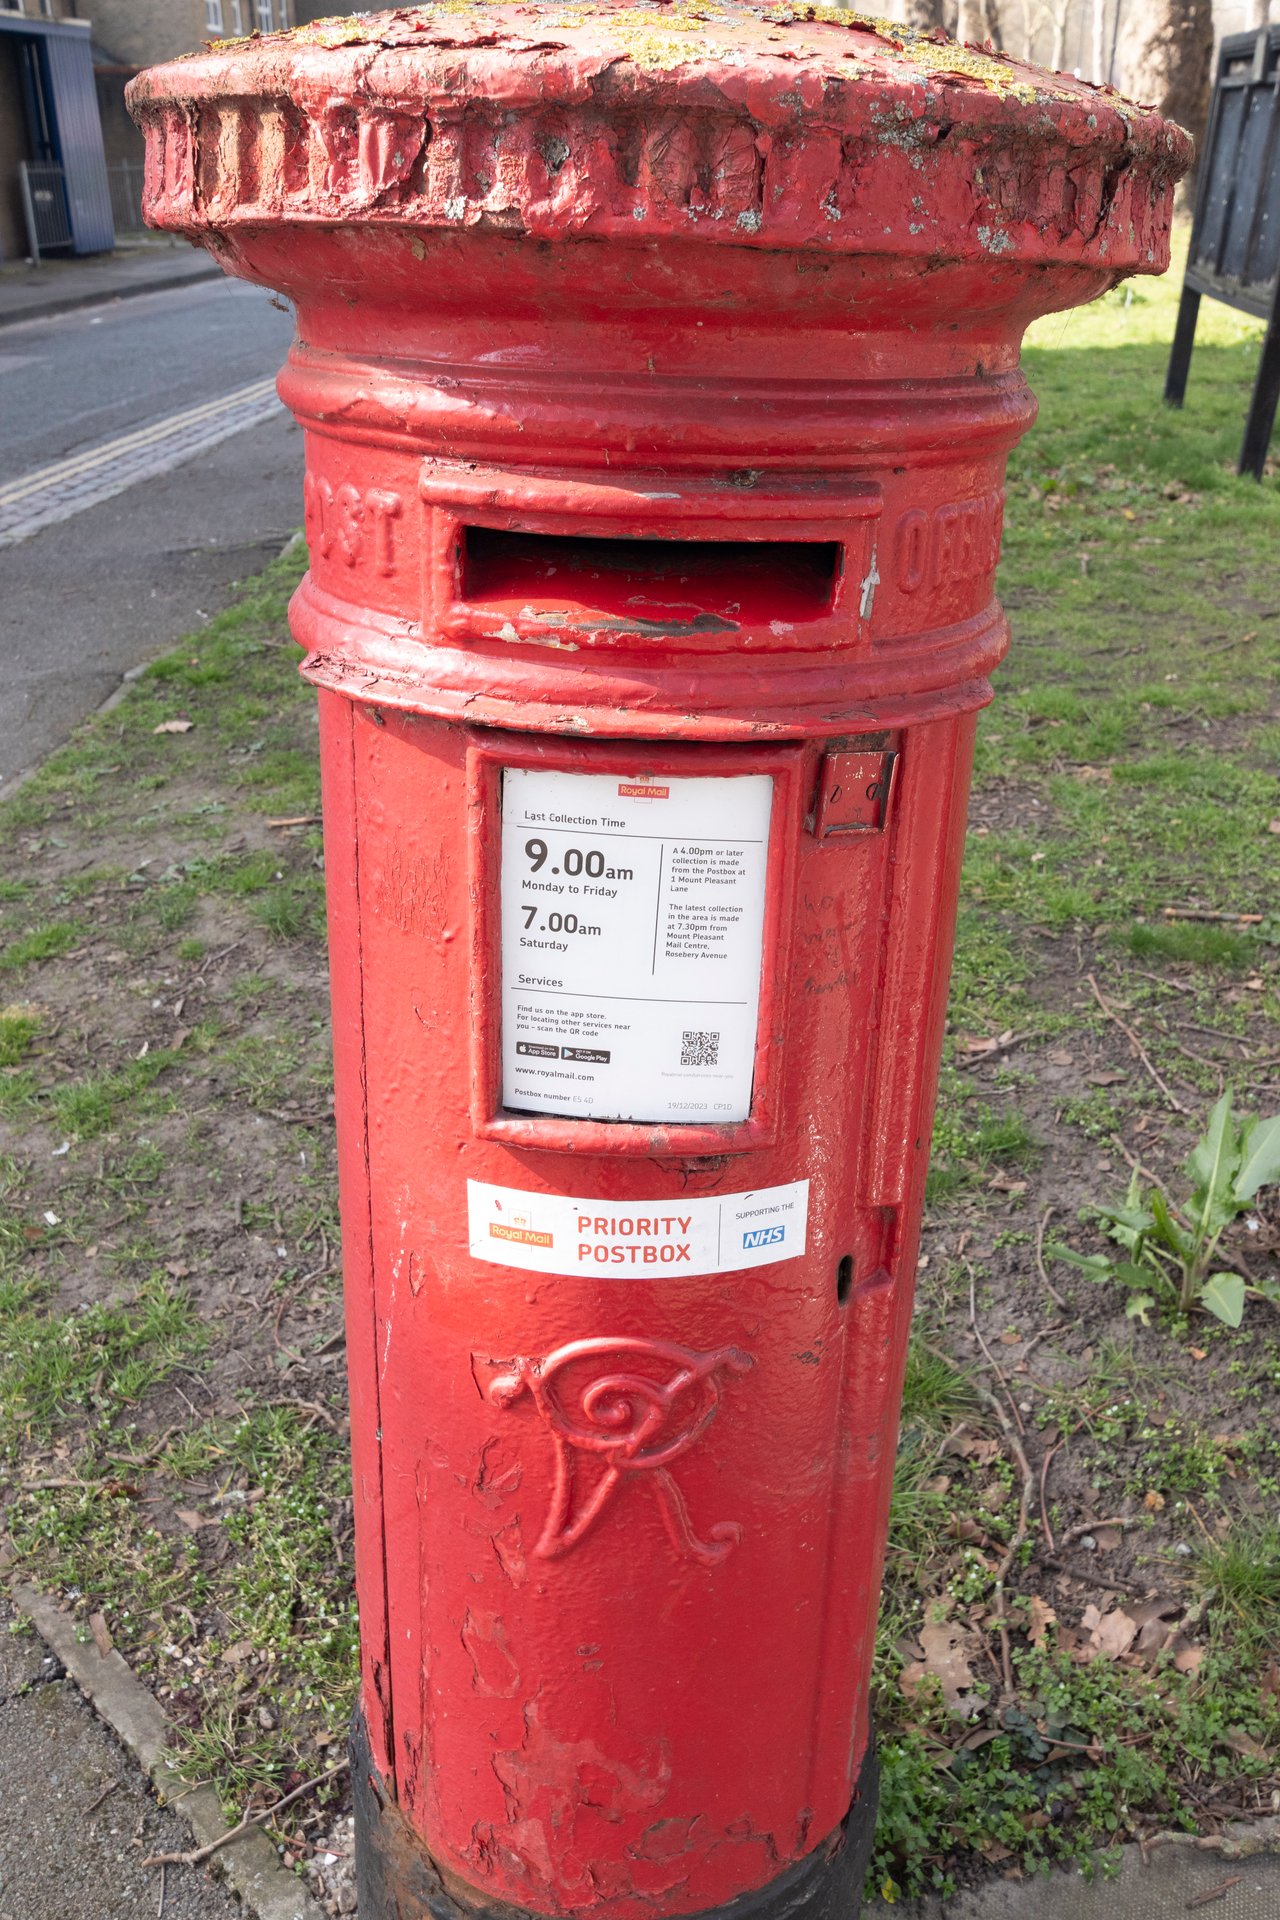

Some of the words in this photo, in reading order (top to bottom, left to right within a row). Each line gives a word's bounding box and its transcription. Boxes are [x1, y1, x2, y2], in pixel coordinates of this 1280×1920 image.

[620, 786, 646, 796] Royal
[647, 788, 666, 796] Mail
[524, 810, 546, 821] Last
[549, 813, 598, 826] Collection
[601, 817, 626, 828] Time
[680, 846, 714, 856] 4.00pm
[524, 838, 634, 881] 9.00am
[522, 879, 564, 894] Monday
[568, 884, 580, 894] to
[583, 885, 618, 898] Friday
[521, 904, 601, 936] 7.00am
[678, 922, 708, 932] 7.30pm
[519, 936, 568, 952] Saturday
[666, 950, 699, 960] Rosebery
[518, 974, 564, 988] Services
[517, 1004, 532, 1012] Find
[570, 1010, 584, 1018] app
[586, 1012, 607, 1020] store.
[530, 1014, 559, 1025] locating
[561, 1018, 580, 1026] other
[582, 1021, 612, 1029] services
[570, 1028, 580, 1036] QR
[582, 1029, 598, 1037] code
[576, 1052, 596, 1061] Google
[596, 1054, 608, 1062] Play
[515, 1066, 594, 1081] www.royalmail.com
[514, 1088, 542, 1098] Postbox
[544, 1092, 570, 1102] number
[668, 1102, 708, 1110] 19/12/2023
[735, 1206, 780, 1220] SUPPORTING
[780, 1202, 794, 1214] THE
[578, 1216, 692, 1236] PRIORITY
[492, 1226, 522, 1242] Royal
[524, 1232, 550, 1245] Mail
[744, 1226, 782, 1247] NHS
[578, 1244, 691, 1264] POSTBOX
